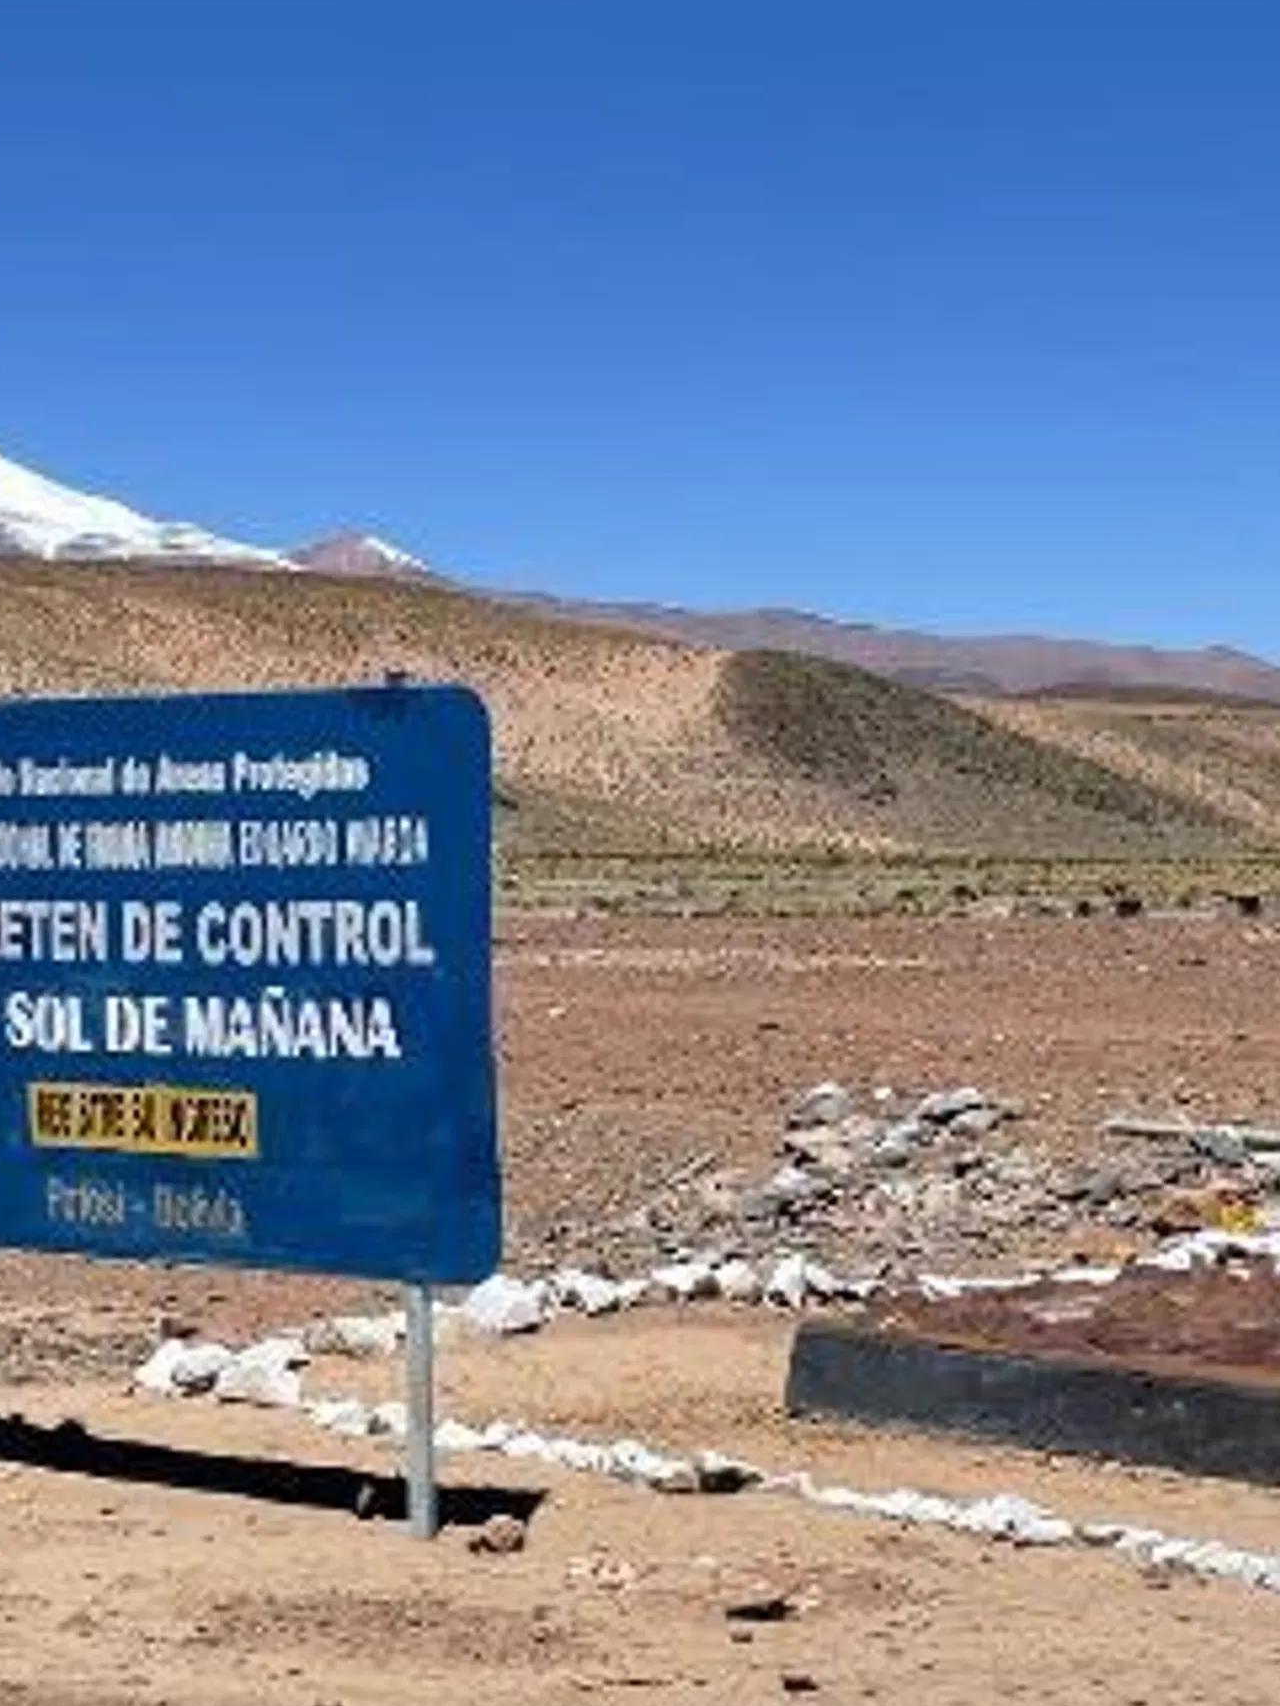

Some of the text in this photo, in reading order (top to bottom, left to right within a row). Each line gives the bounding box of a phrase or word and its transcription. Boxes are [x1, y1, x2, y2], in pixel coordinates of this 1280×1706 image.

[122, 902, 183, 962] DE
[196, 900, 436, 967] CONTROL
[4, 986, 402, 1058] SOL DE MAÑANA
